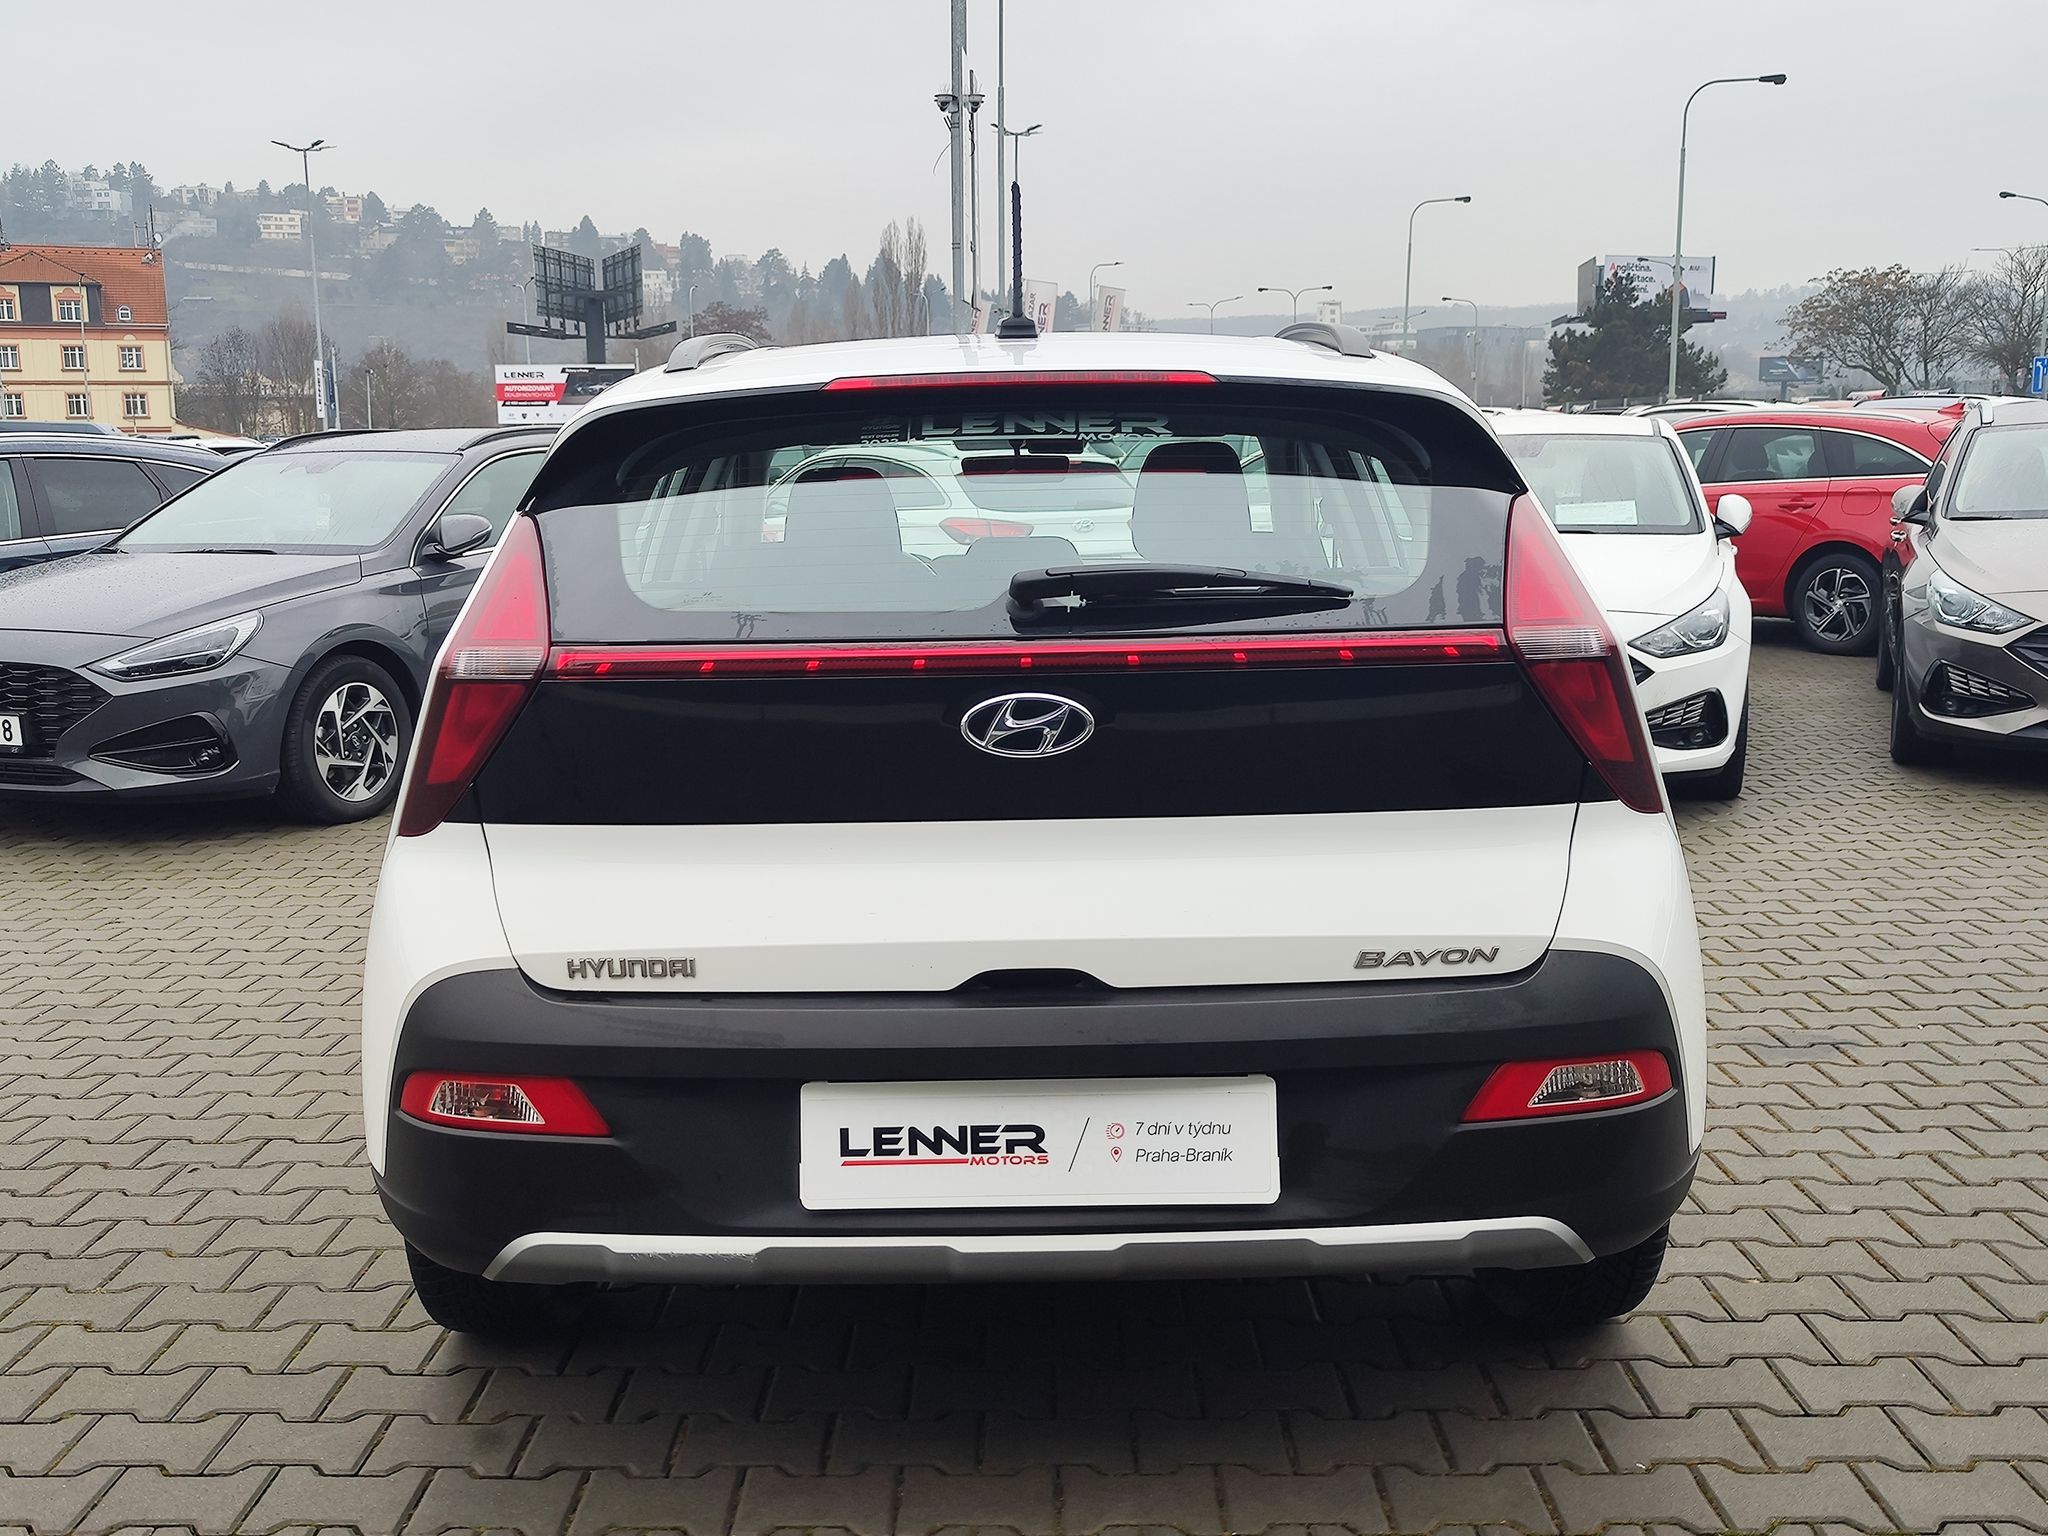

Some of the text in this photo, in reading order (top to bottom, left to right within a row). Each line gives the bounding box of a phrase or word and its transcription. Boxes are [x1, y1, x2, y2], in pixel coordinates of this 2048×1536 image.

[504, 371, 544, 379] LENNER
[921, 411, 1173, 435] LENNER
[2, 719, 13, 742] 8
[567, 957, 697, 979] HYUNDAI
[1353, 946, 1500, 969] BAYON
[839, 1124, 1049, 1157] LENNER
[1135, 1121, 1232, 1139] 7 dní v týdnu
[969, 1155, 1049, 1166] MOTORS
[1135, 1147, 1233, 1162] Praha-Braník
